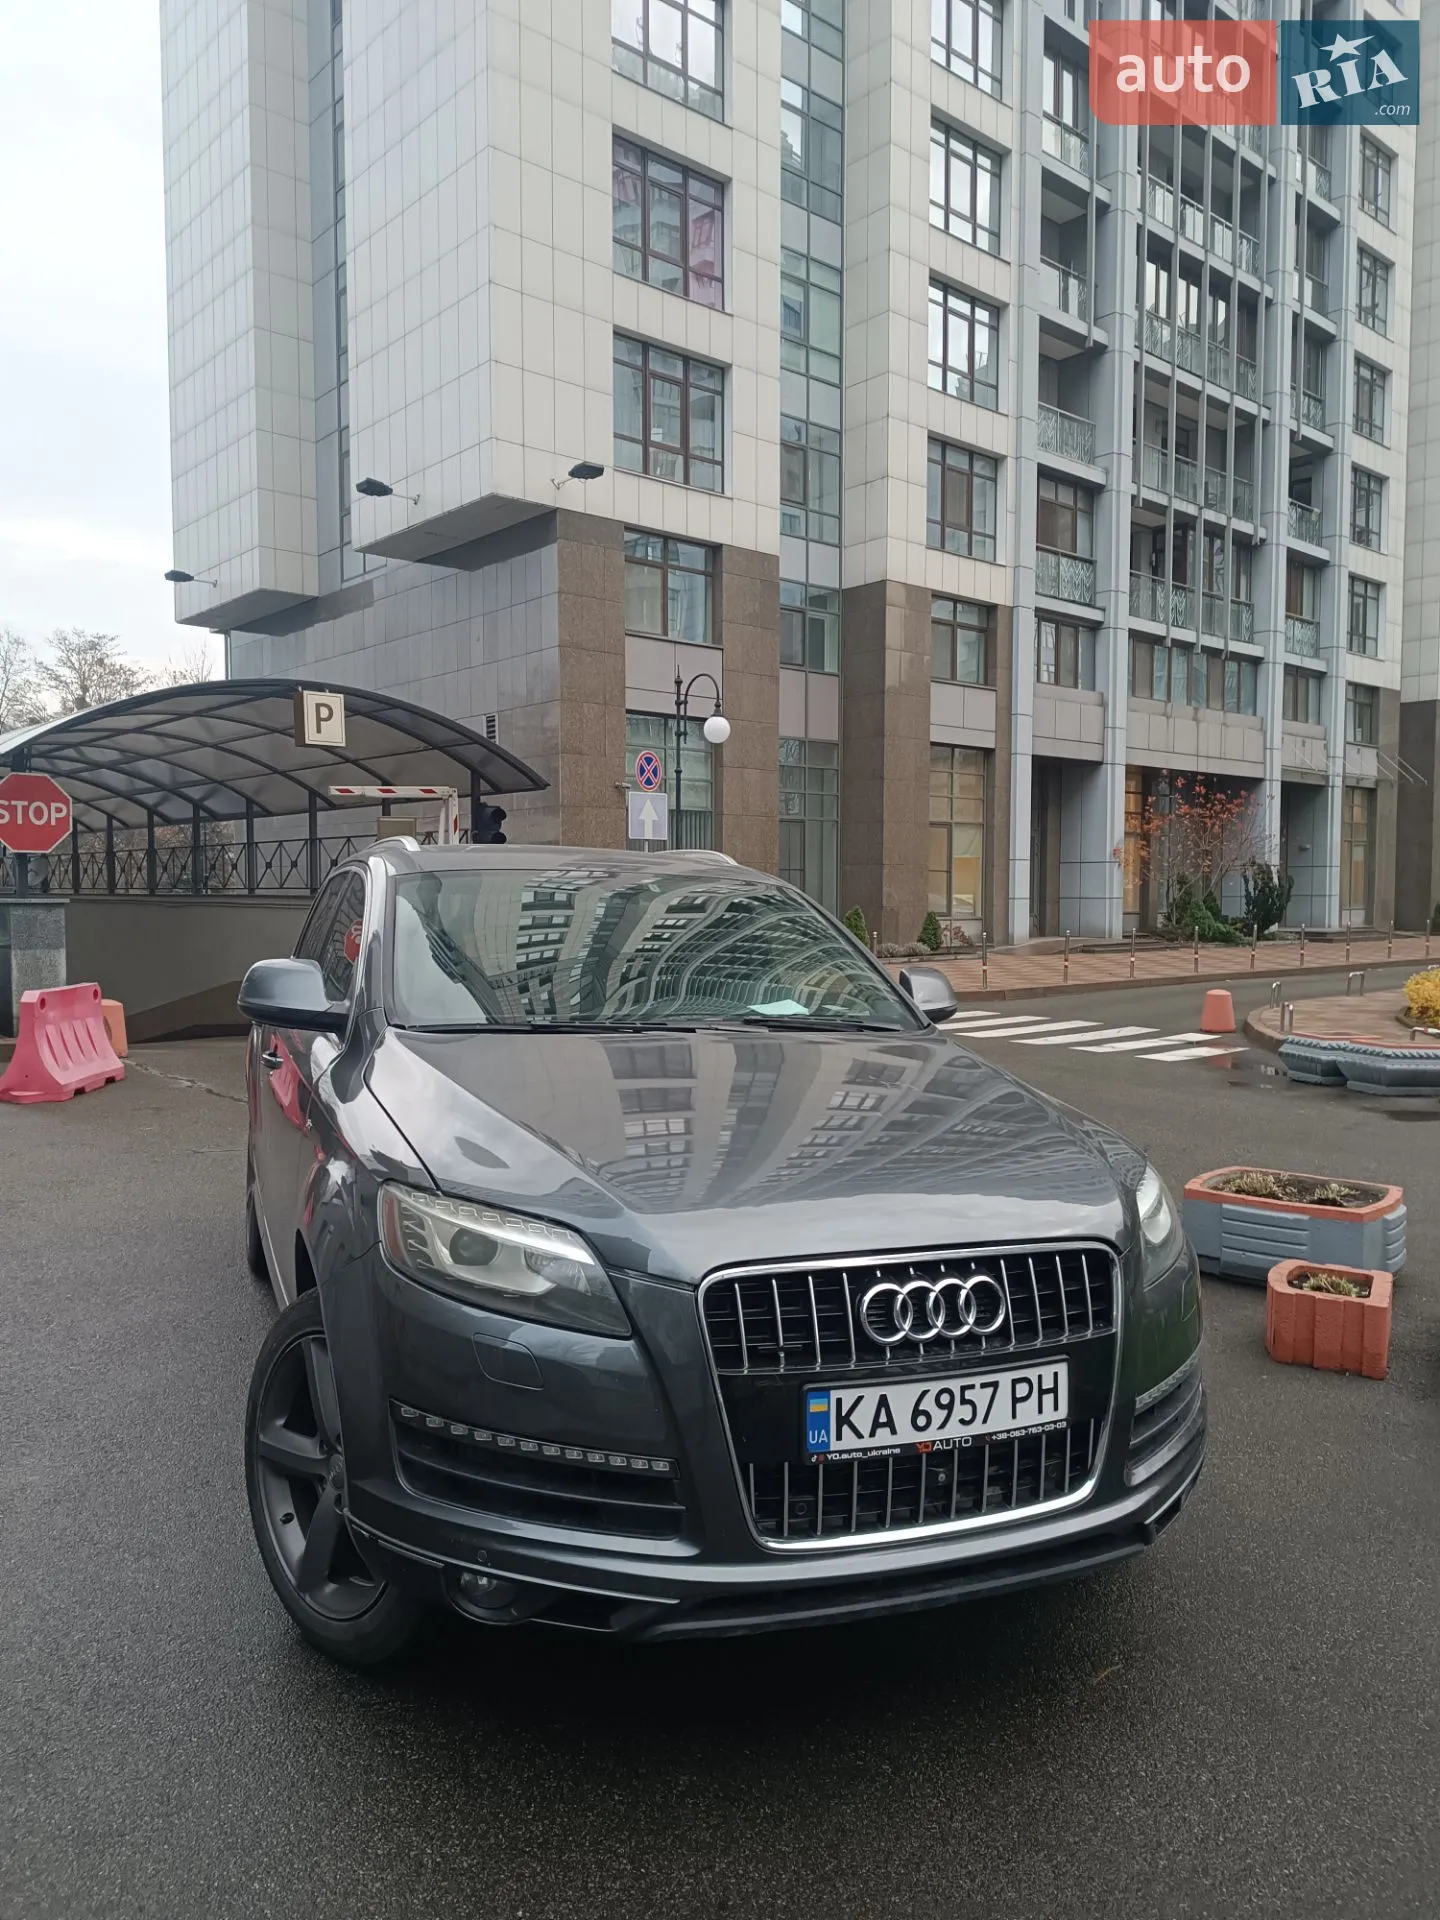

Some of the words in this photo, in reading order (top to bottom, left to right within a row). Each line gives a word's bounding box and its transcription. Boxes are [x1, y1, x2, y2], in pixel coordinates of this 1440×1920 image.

[315, 702, 334, 735] P
[835, 1393, 898, 1442] KA
[910, 1380, 1000, 1432] 6957
[1011, 1371, 1059, 1420] PH
[809, 1428, 829, 1445] UA
